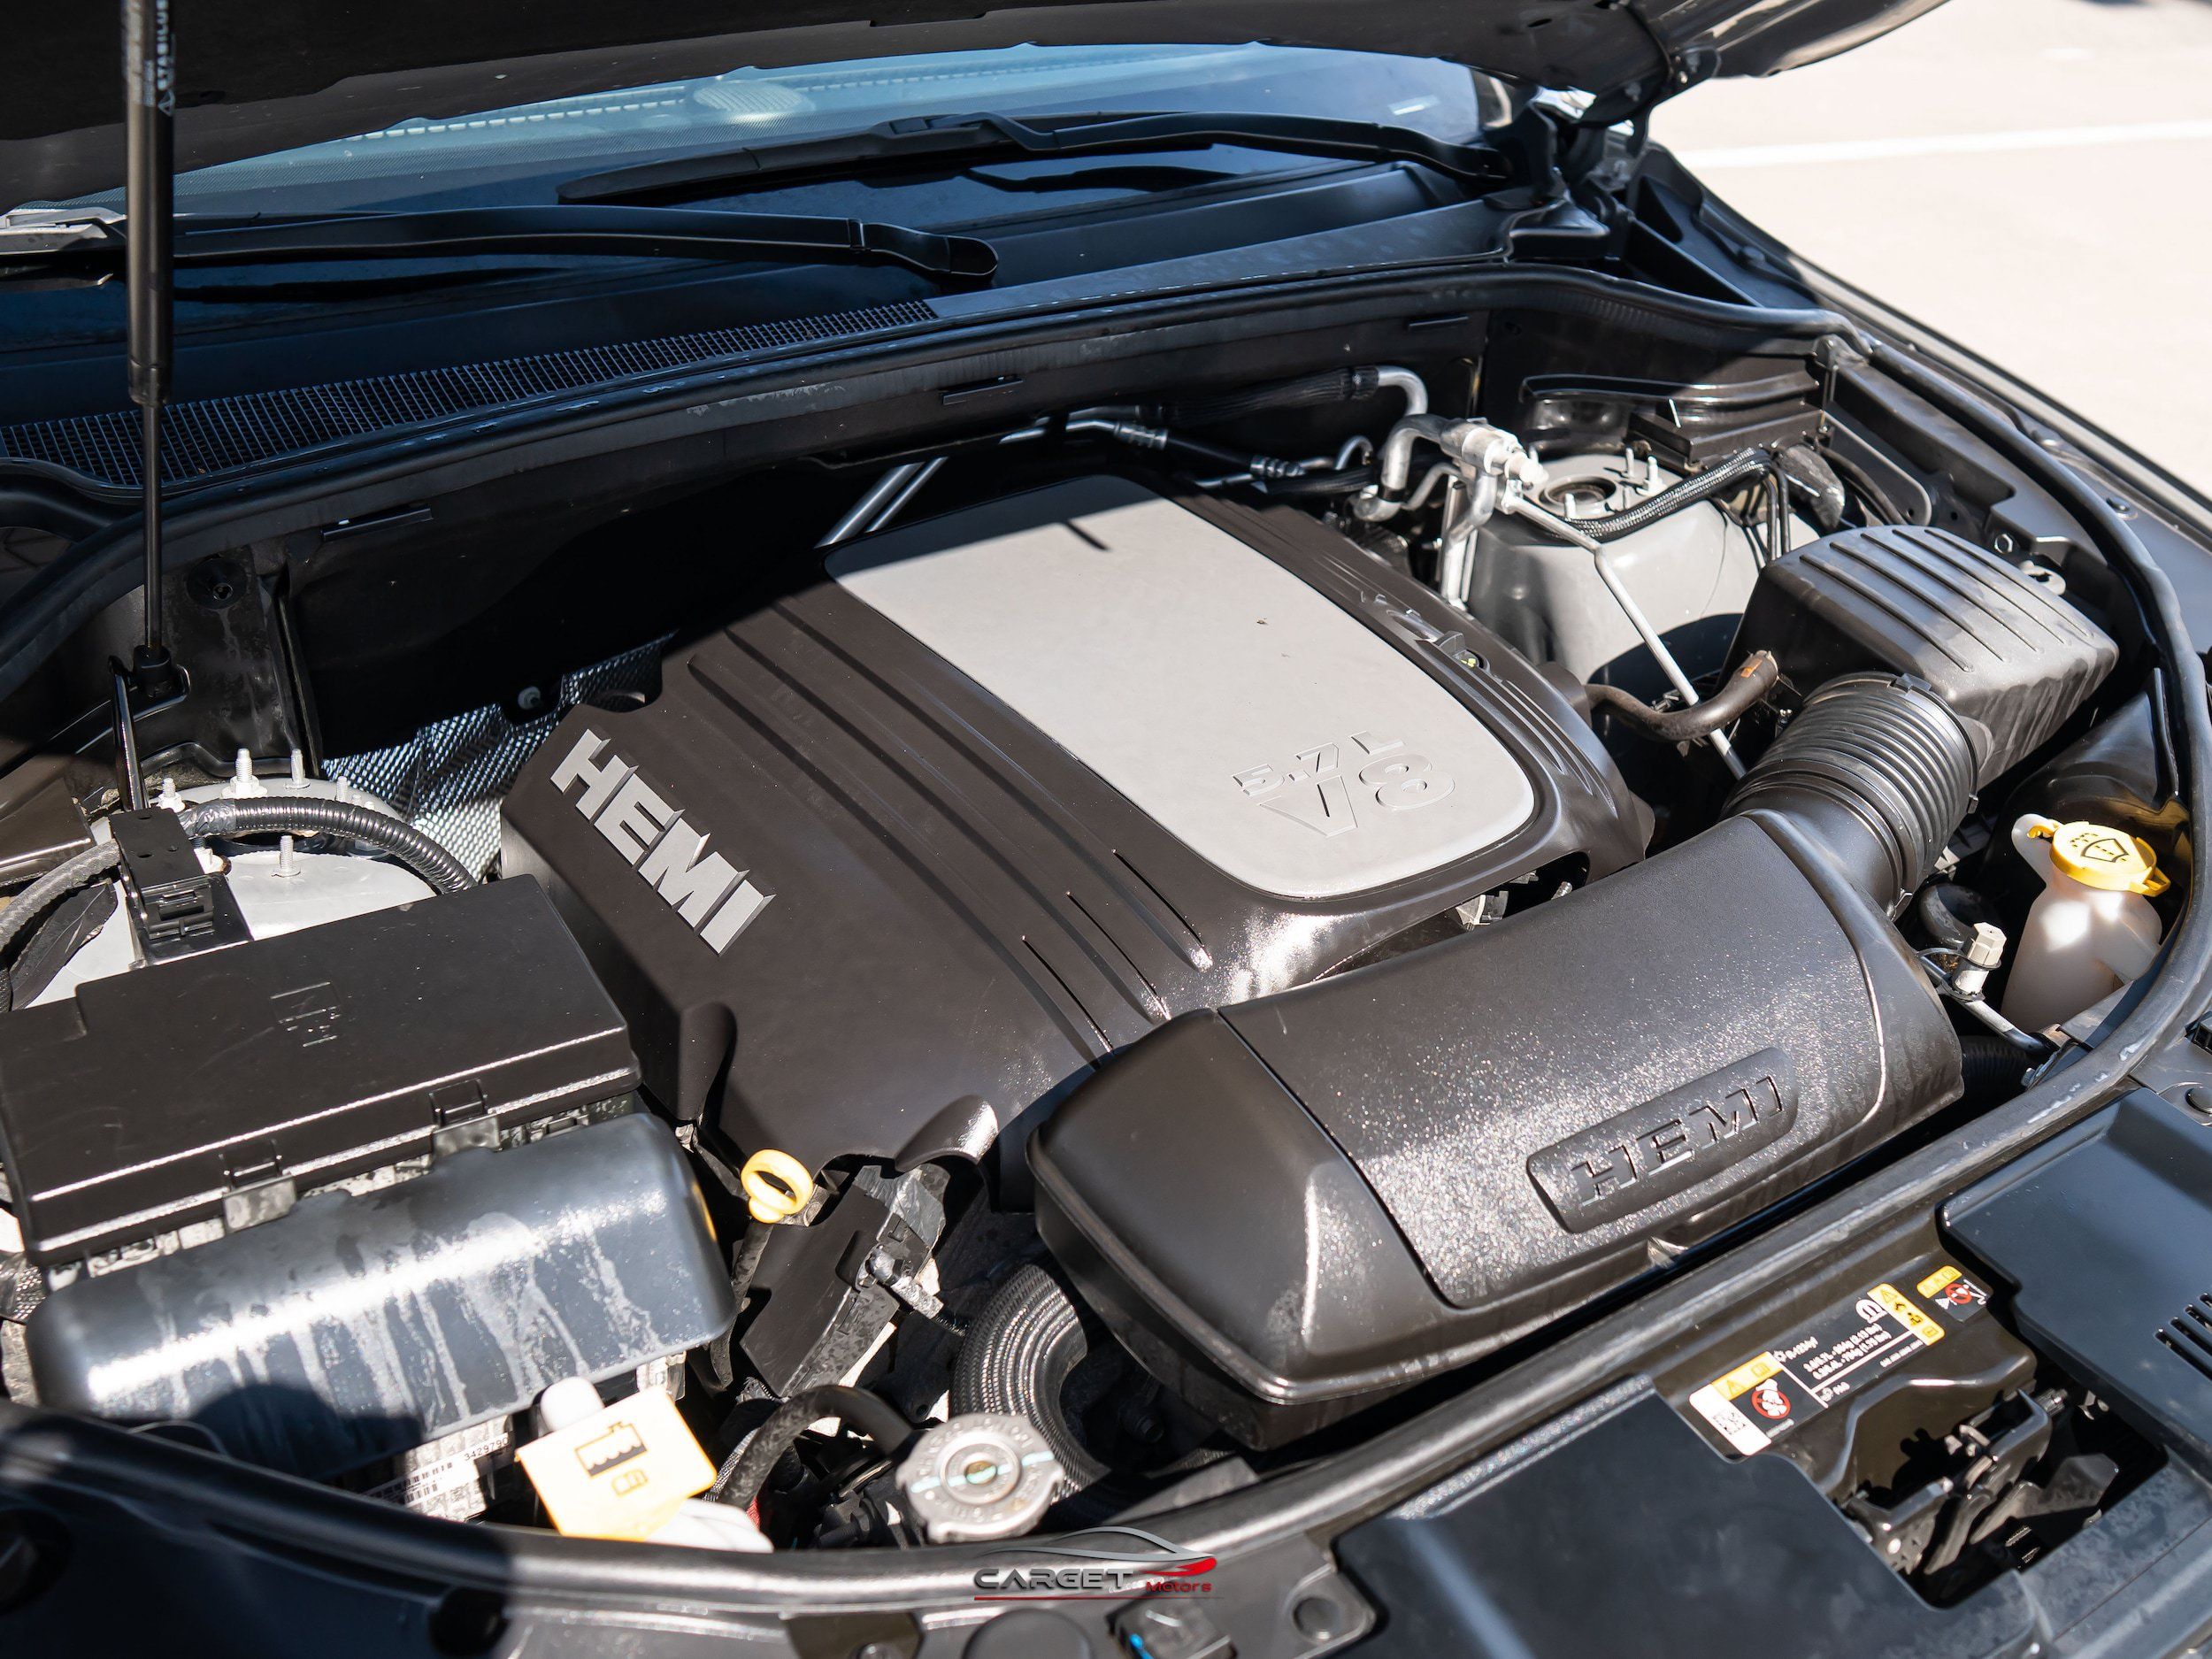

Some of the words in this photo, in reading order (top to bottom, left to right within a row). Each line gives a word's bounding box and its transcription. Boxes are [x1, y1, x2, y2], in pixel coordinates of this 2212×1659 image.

[550, 728, 776, 956] HEMI
[1257, 753, 1455, 837] V8
[1571, 1074, 1783, 1207] HEMI
